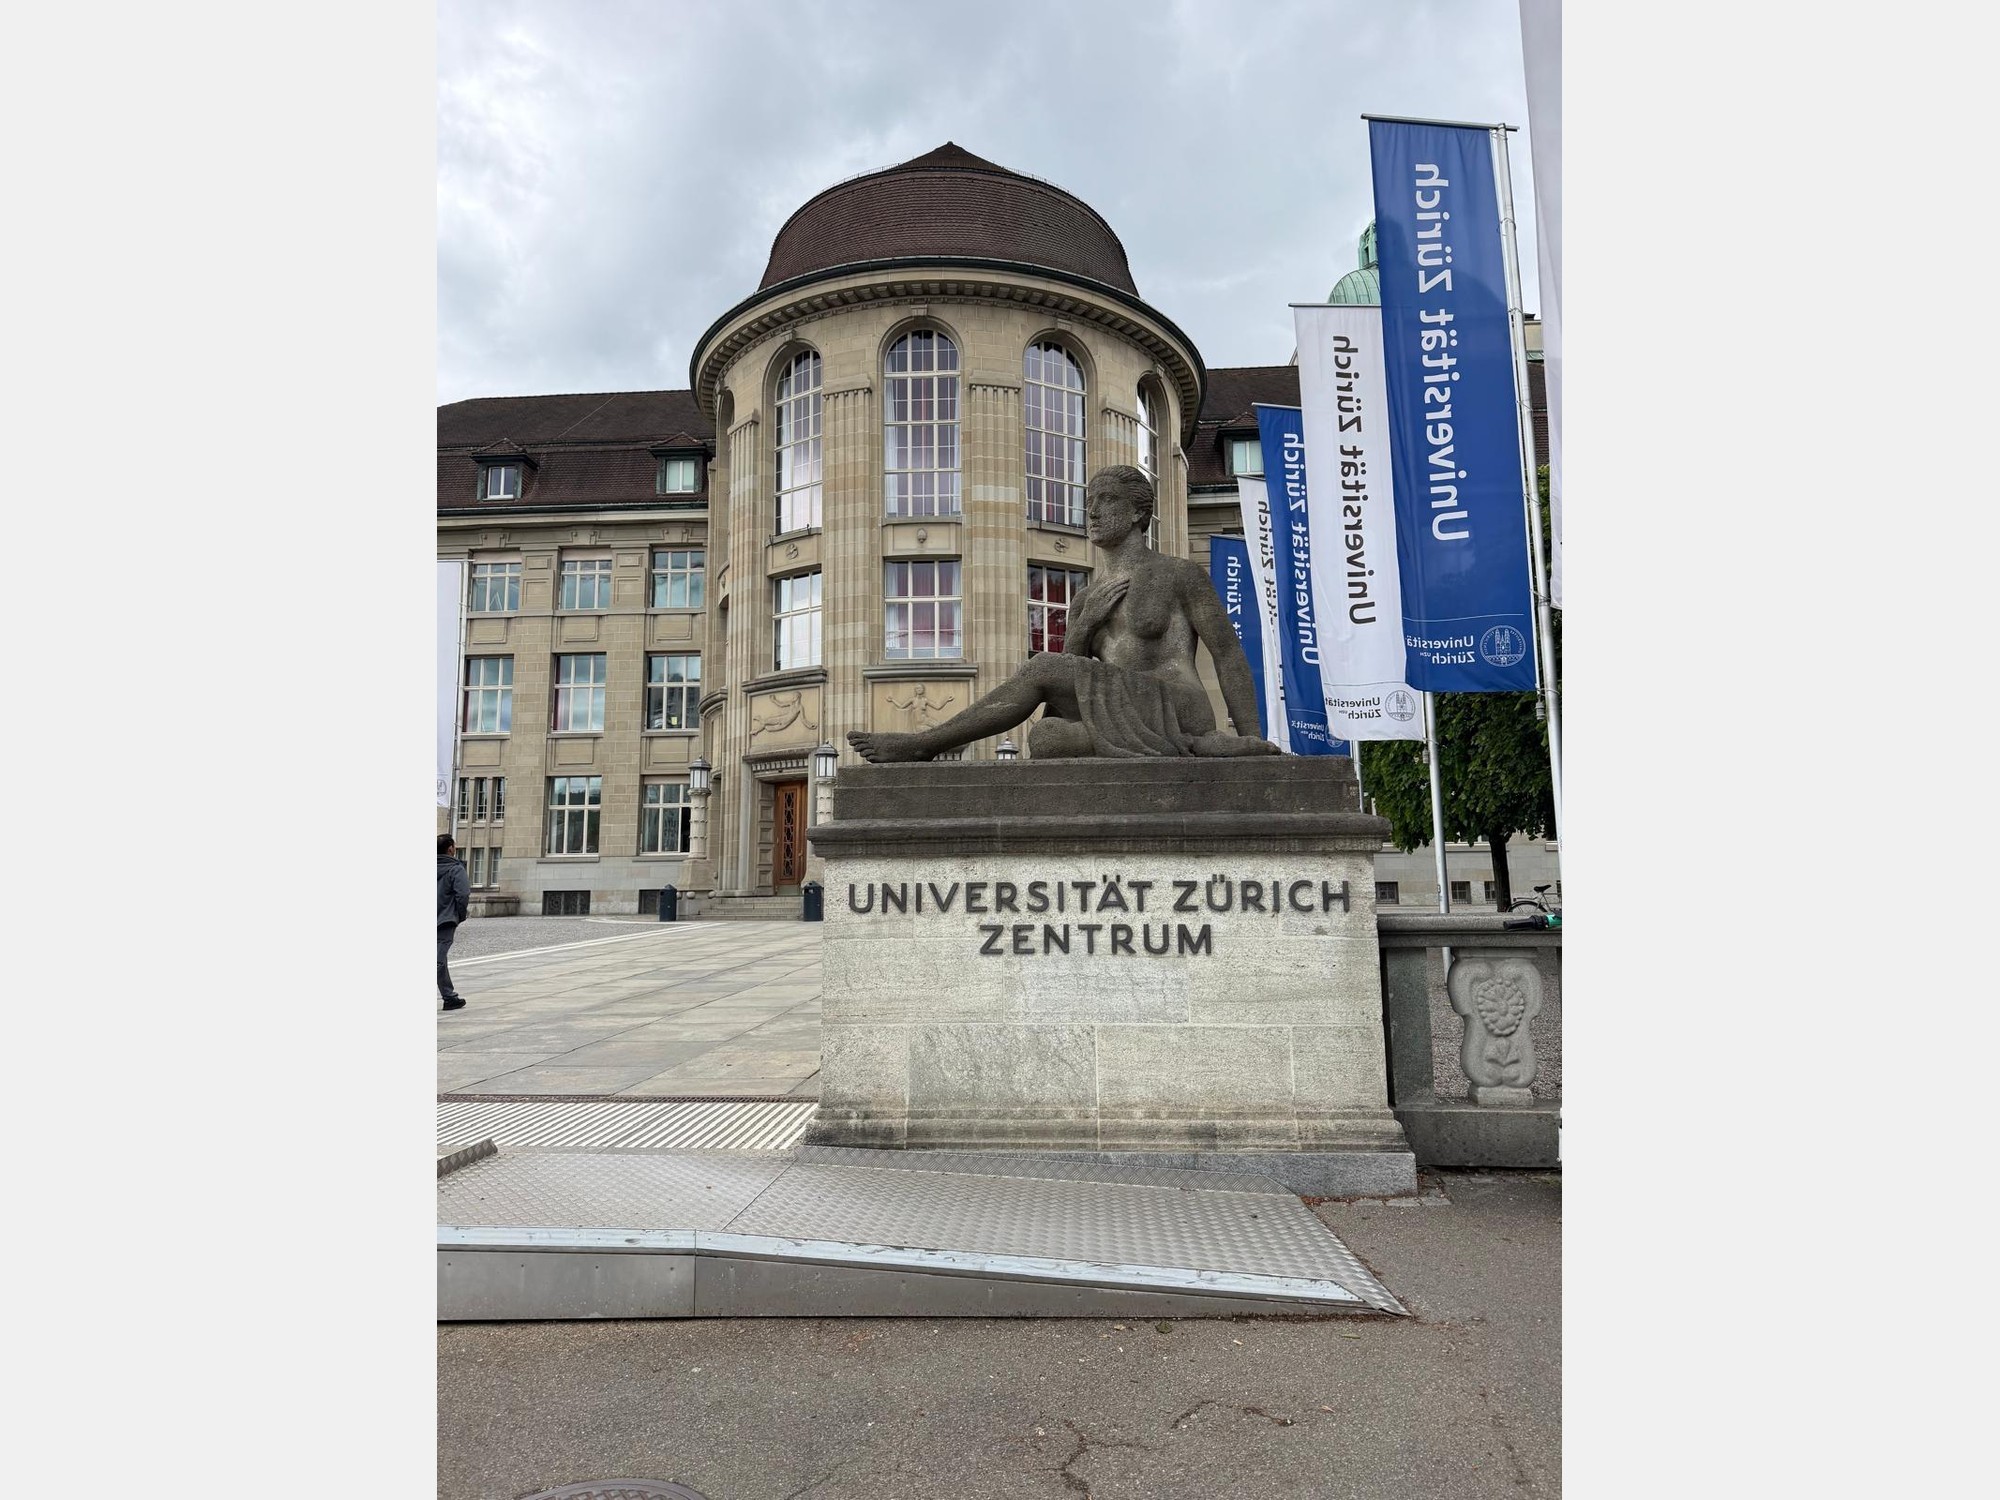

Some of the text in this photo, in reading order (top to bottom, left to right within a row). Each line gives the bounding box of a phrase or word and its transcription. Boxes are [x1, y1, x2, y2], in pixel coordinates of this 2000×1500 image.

[848, 874, 1351, 915] UNIVERSITÄT ZÜRICH
[979, 923, 1213, 957] ZENTRUM
